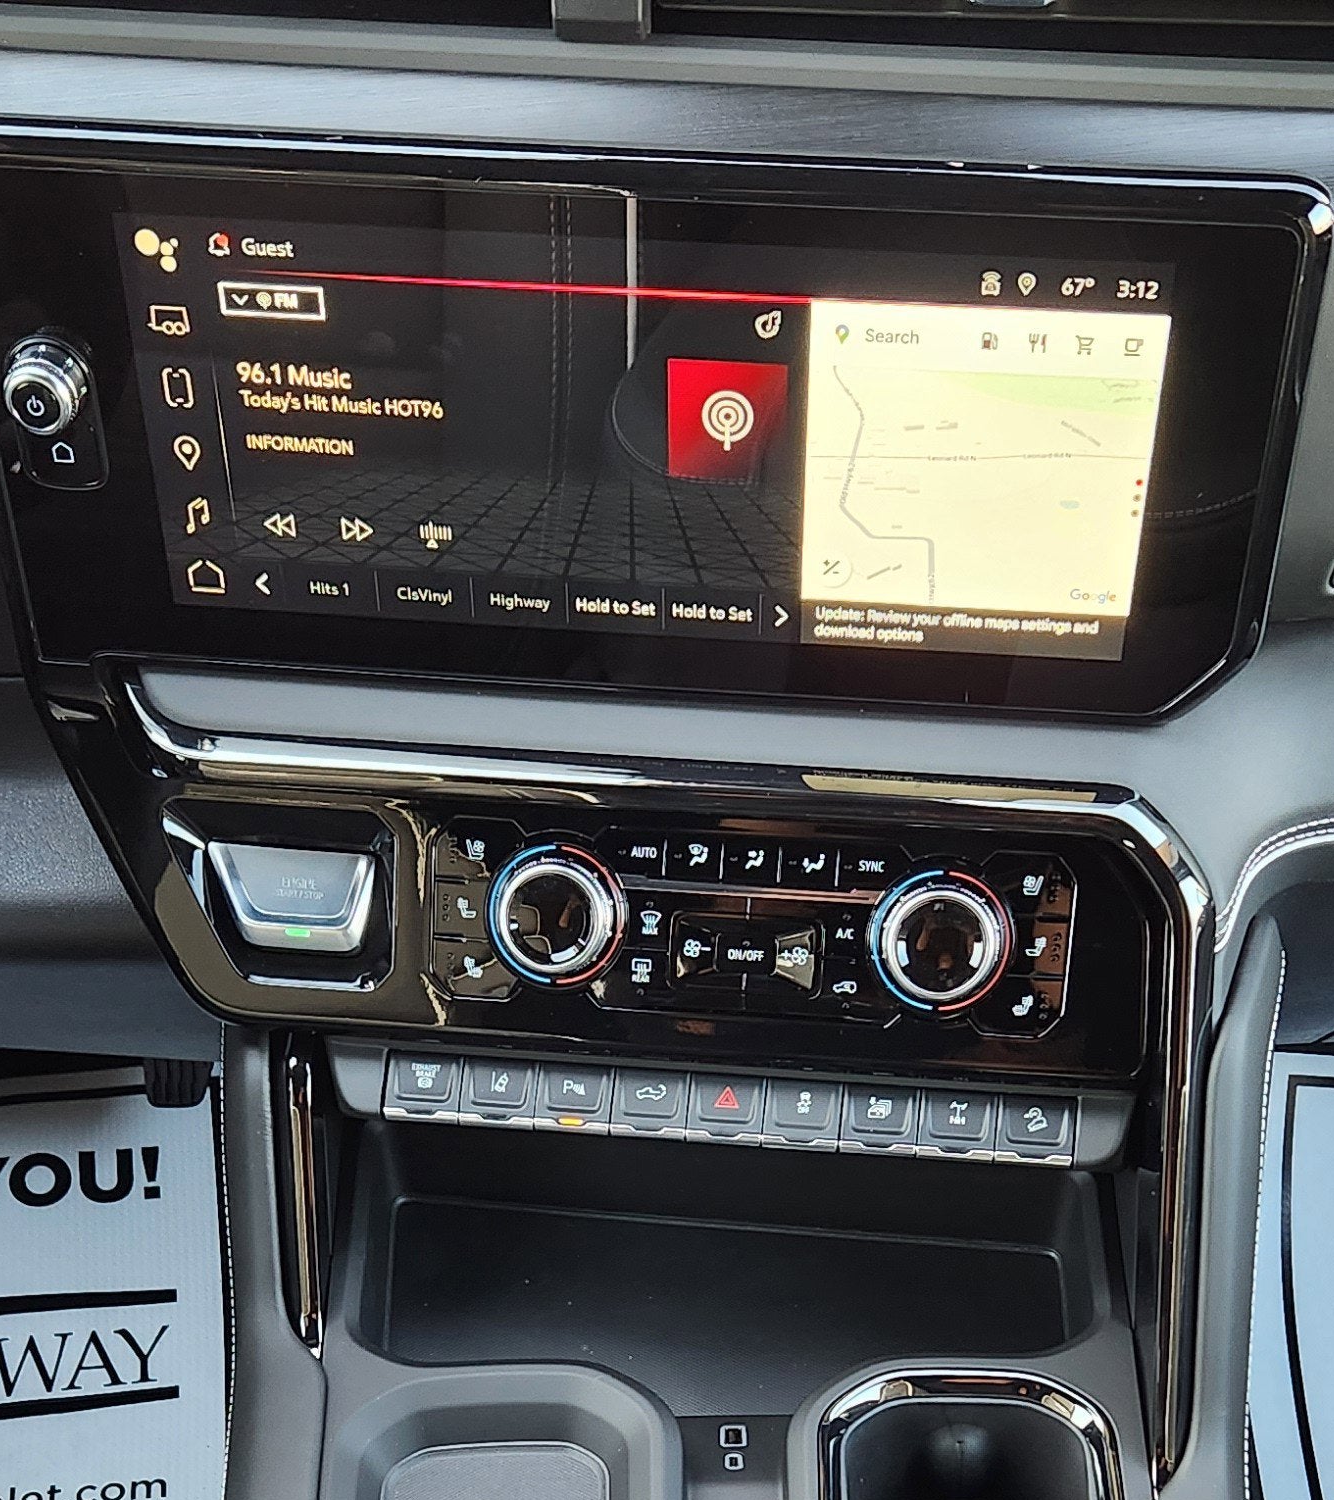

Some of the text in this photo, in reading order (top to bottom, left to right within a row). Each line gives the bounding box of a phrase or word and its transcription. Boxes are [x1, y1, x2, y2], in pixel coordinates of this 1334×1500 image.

[241, 237, 295, 258] Guest
[1116, 280, 1159, 300] 3:12
[274, 292, 299, 309] FM
[865, 328, 920, 346] Search
[235, 361, 353, 390] 96.1 Music
[238, 389, 444, 419] Today's Hit Music HOT96
[246, 434, 355, 456] INFORMATION
[309, 580, 350, 597] Hits 1
[396, 586, 452, 604] ClsVinyl
[1070, 588, 1116, 604] Google
[489, 592, 551, 612] Highway
[575, 597, 656, 618] Hold to Set
[671, 603, 753, 624] Hold to Set
[815, 606, 1099, 636] Update: Review your offline maps settings and
[814, 624, 924, 644] download options
[630, 846, 658, 859] AUTO
[858, 860, 886, 873] SYNC
[835, 928, 855, 940] A/C
[727, 948, 765, 962] ON/OFF
